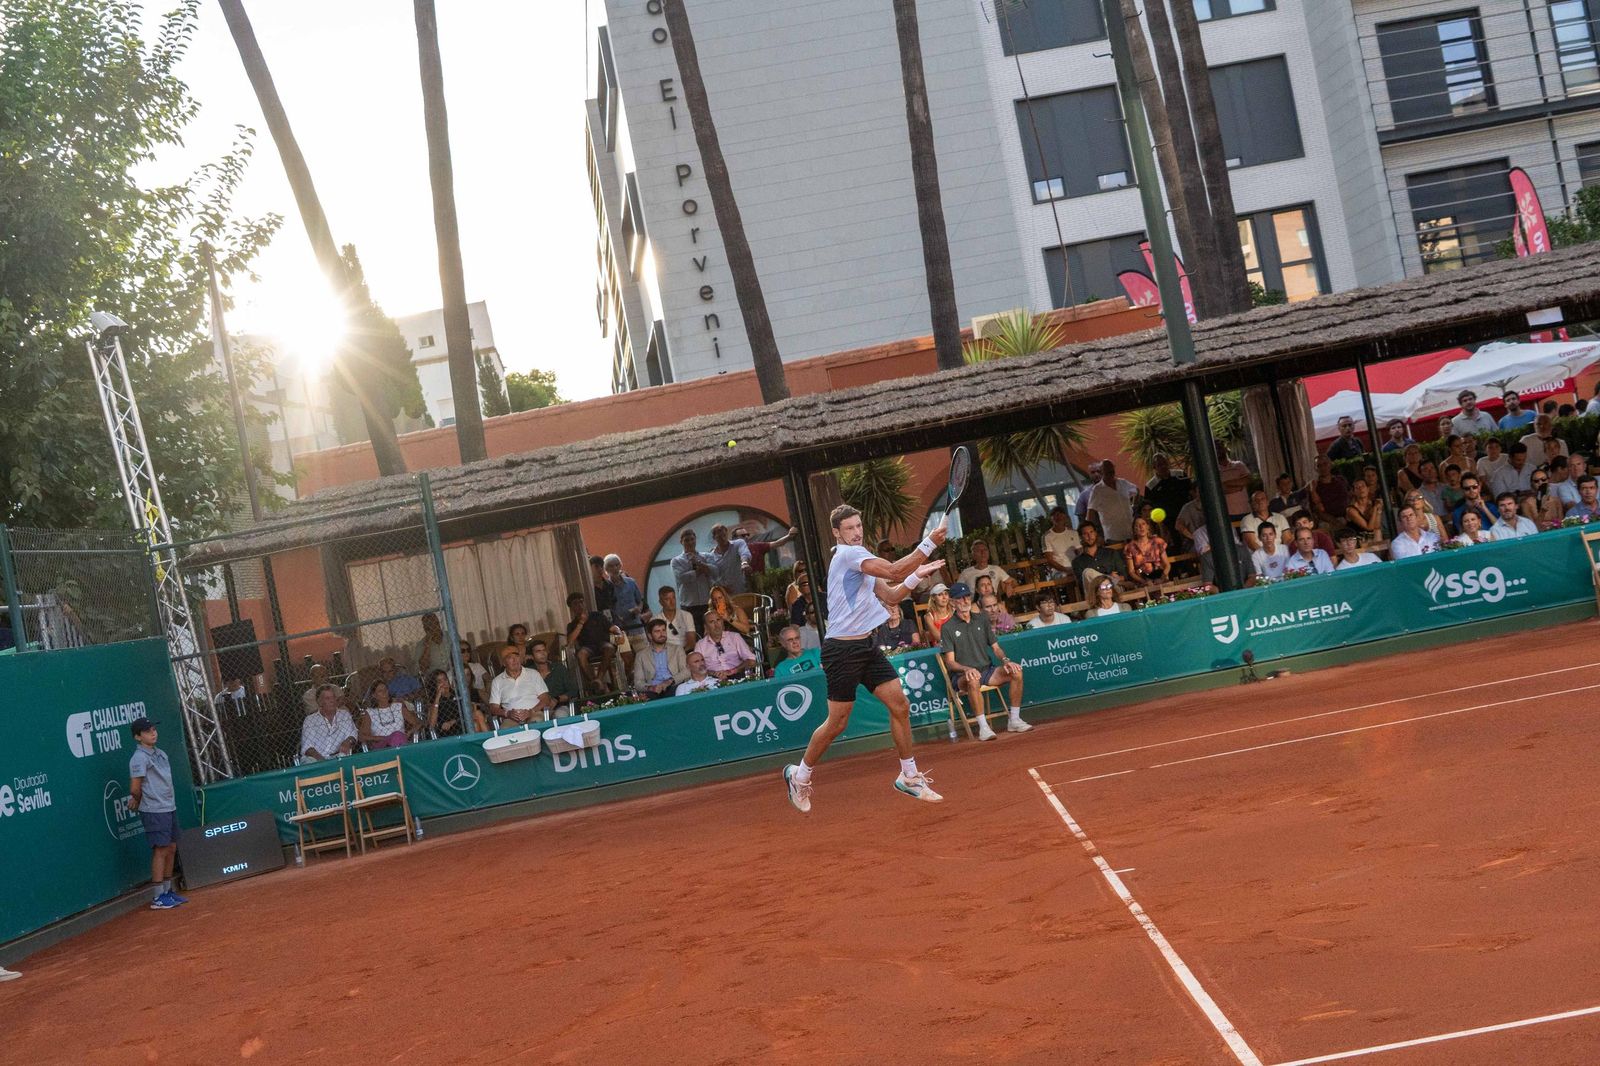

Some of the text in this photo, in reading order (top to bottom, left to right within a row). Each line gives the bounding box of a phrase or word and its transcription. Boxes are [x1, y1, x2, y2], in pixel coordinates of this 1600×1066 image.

[675, 163, 728, 374] Porveni
[1245, 601, 1353, 631] JUAN FERIA
[1047, 633, 1099, 650] Montero
[1019, 646, 1091, 668] Aramburu &
[1086, 666, 1128, 682] Atencia
[92, 701, 147, 731] CHALLENGER
[713, 705, 778, 741] FOX
[96, 729, 122, 754] TOUR
[756, 731, 780, 744] ESS
[17, 787, 52, 813] Sevilla
[205, 821, 248, 838] SPEED
[222, 862, 248, 874] KM/H
